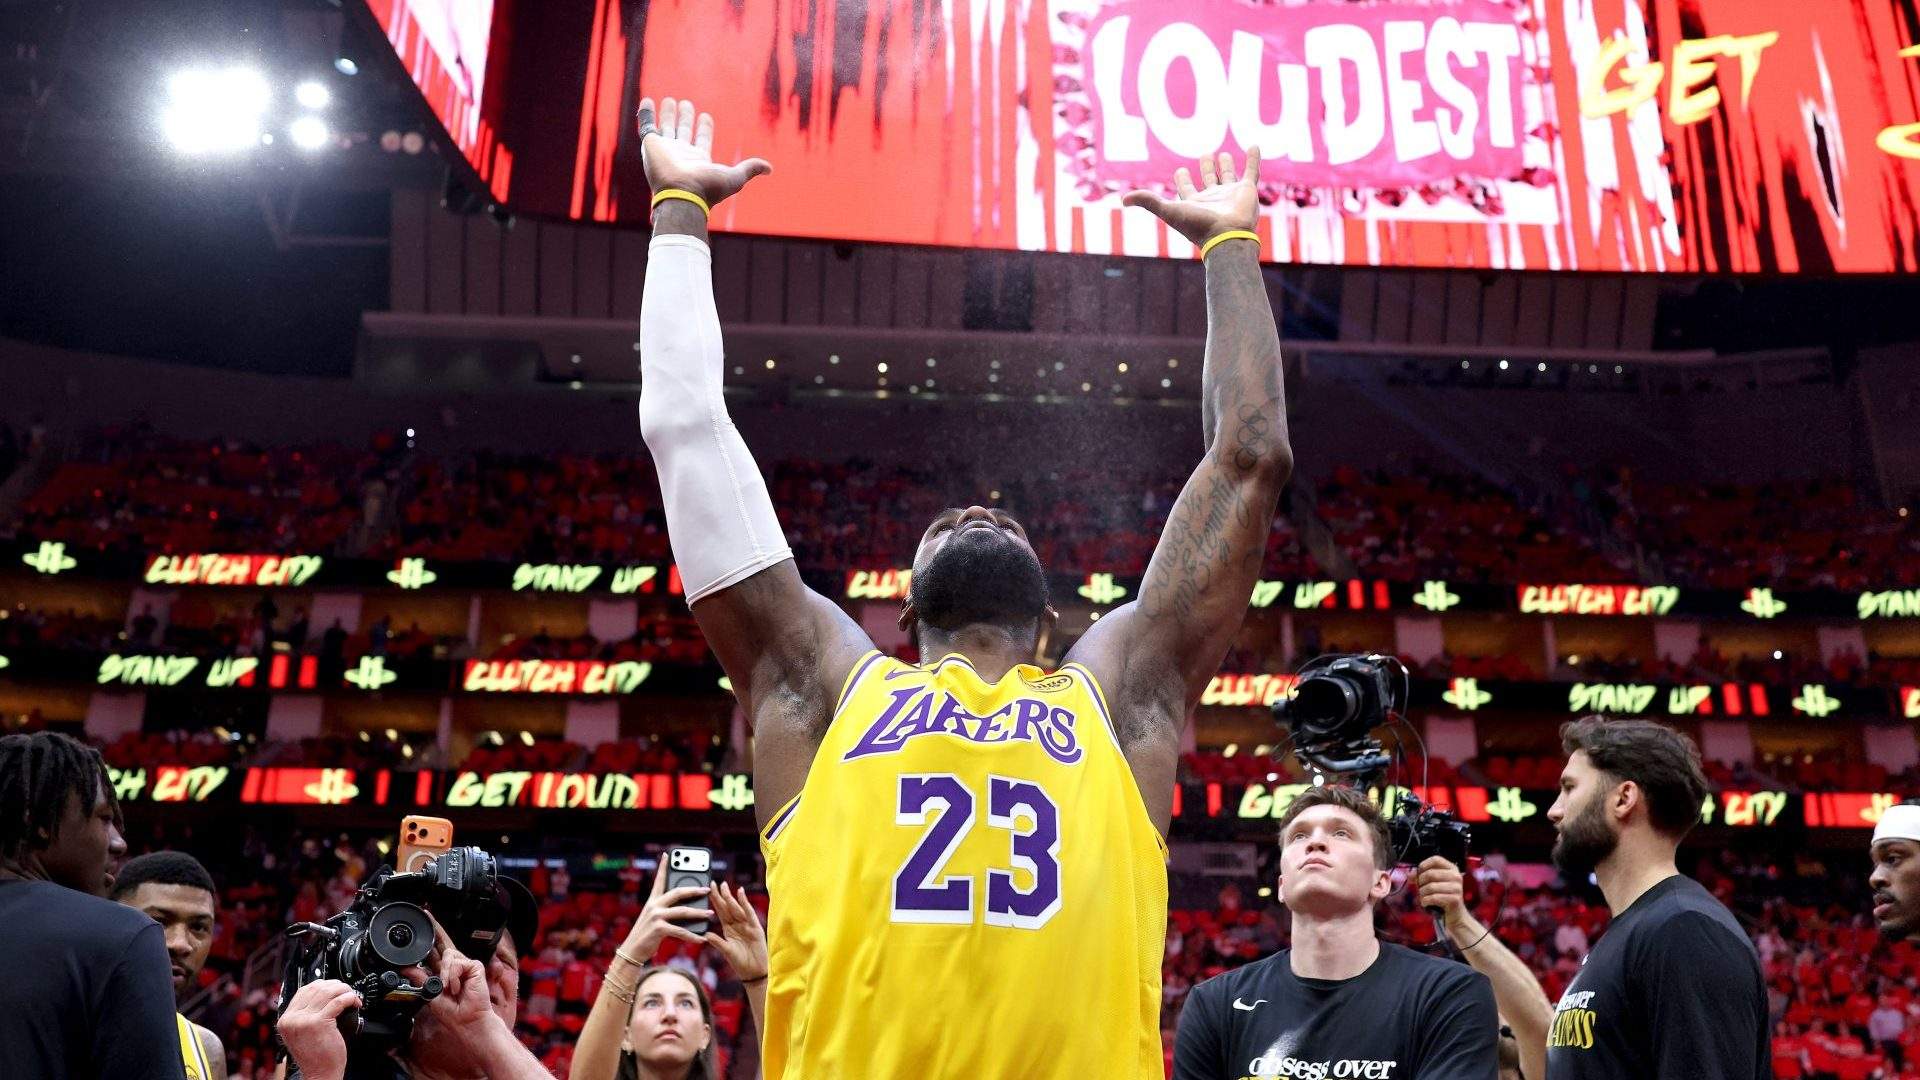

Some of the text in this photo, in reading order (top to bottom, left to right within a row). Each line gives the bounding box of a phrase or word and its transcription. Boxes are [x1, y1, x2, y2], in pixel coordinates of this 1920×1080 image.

[1578, 31, 1780, 126] GET
[145, 553, 322, 585] CLUTCH CITY
[513, 563, 657, 594] STAND UP
[847, 568, 912, 599] CLUT
[1295, 581, 1337, 609] UP
[1520, 584, 1680, 616] CLUTCH CITY
[1857, 589, 1920, 619] STAN
[97, 654, 259, 687] STAND UP
[464, 659, 651, 694] CLUTCH CITY
[1568, 683, 1711, 714] STAND UP
[840, 685, 1083, 763] LAKERS
[152, 766, 229, 802] CITY
[446, 771, 532, 807] GET
[1725, 791, 1787, 826] CITY
[890, 772, 1063, 930] 23
[1333, 1059, 1397, 1080] over
